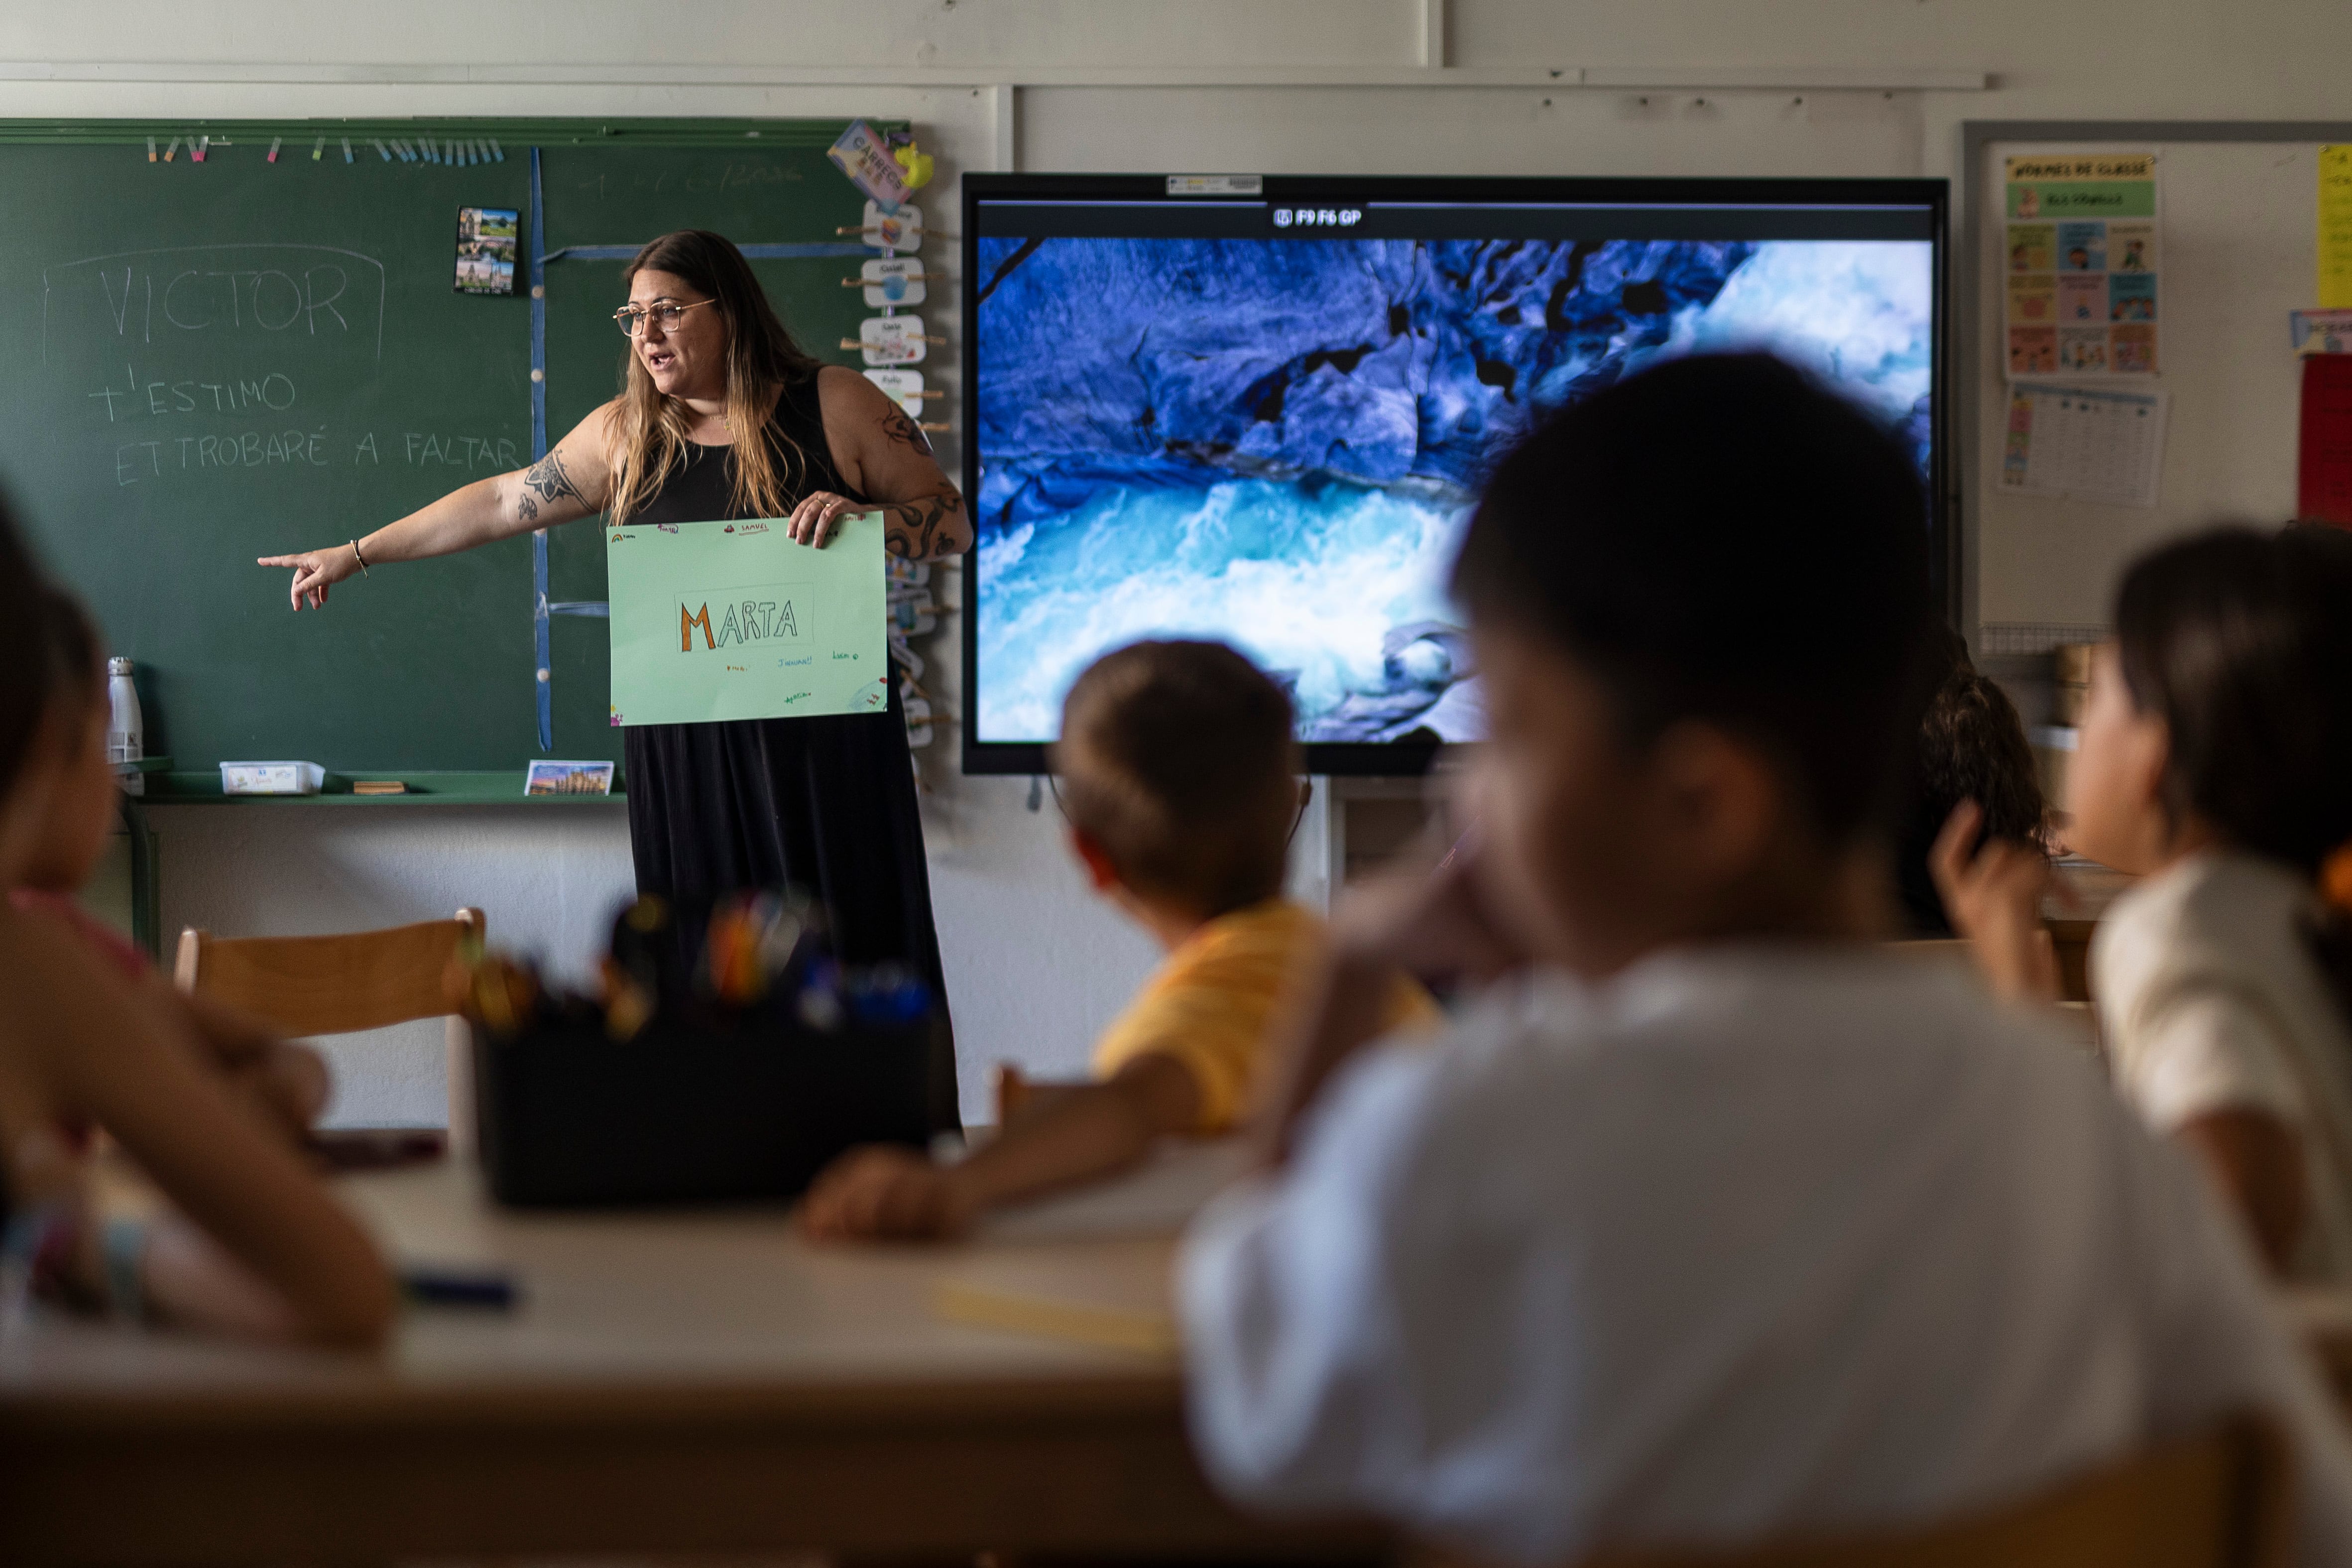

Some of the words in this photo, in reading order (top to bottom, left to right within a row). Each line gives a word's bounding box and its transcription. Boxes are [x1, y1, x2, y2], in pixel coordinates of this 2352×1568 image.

[102, 265, 348, 343] VICTOR
[355, 432, 378, 465] A
[681, 599, 798, 652] MARTA
